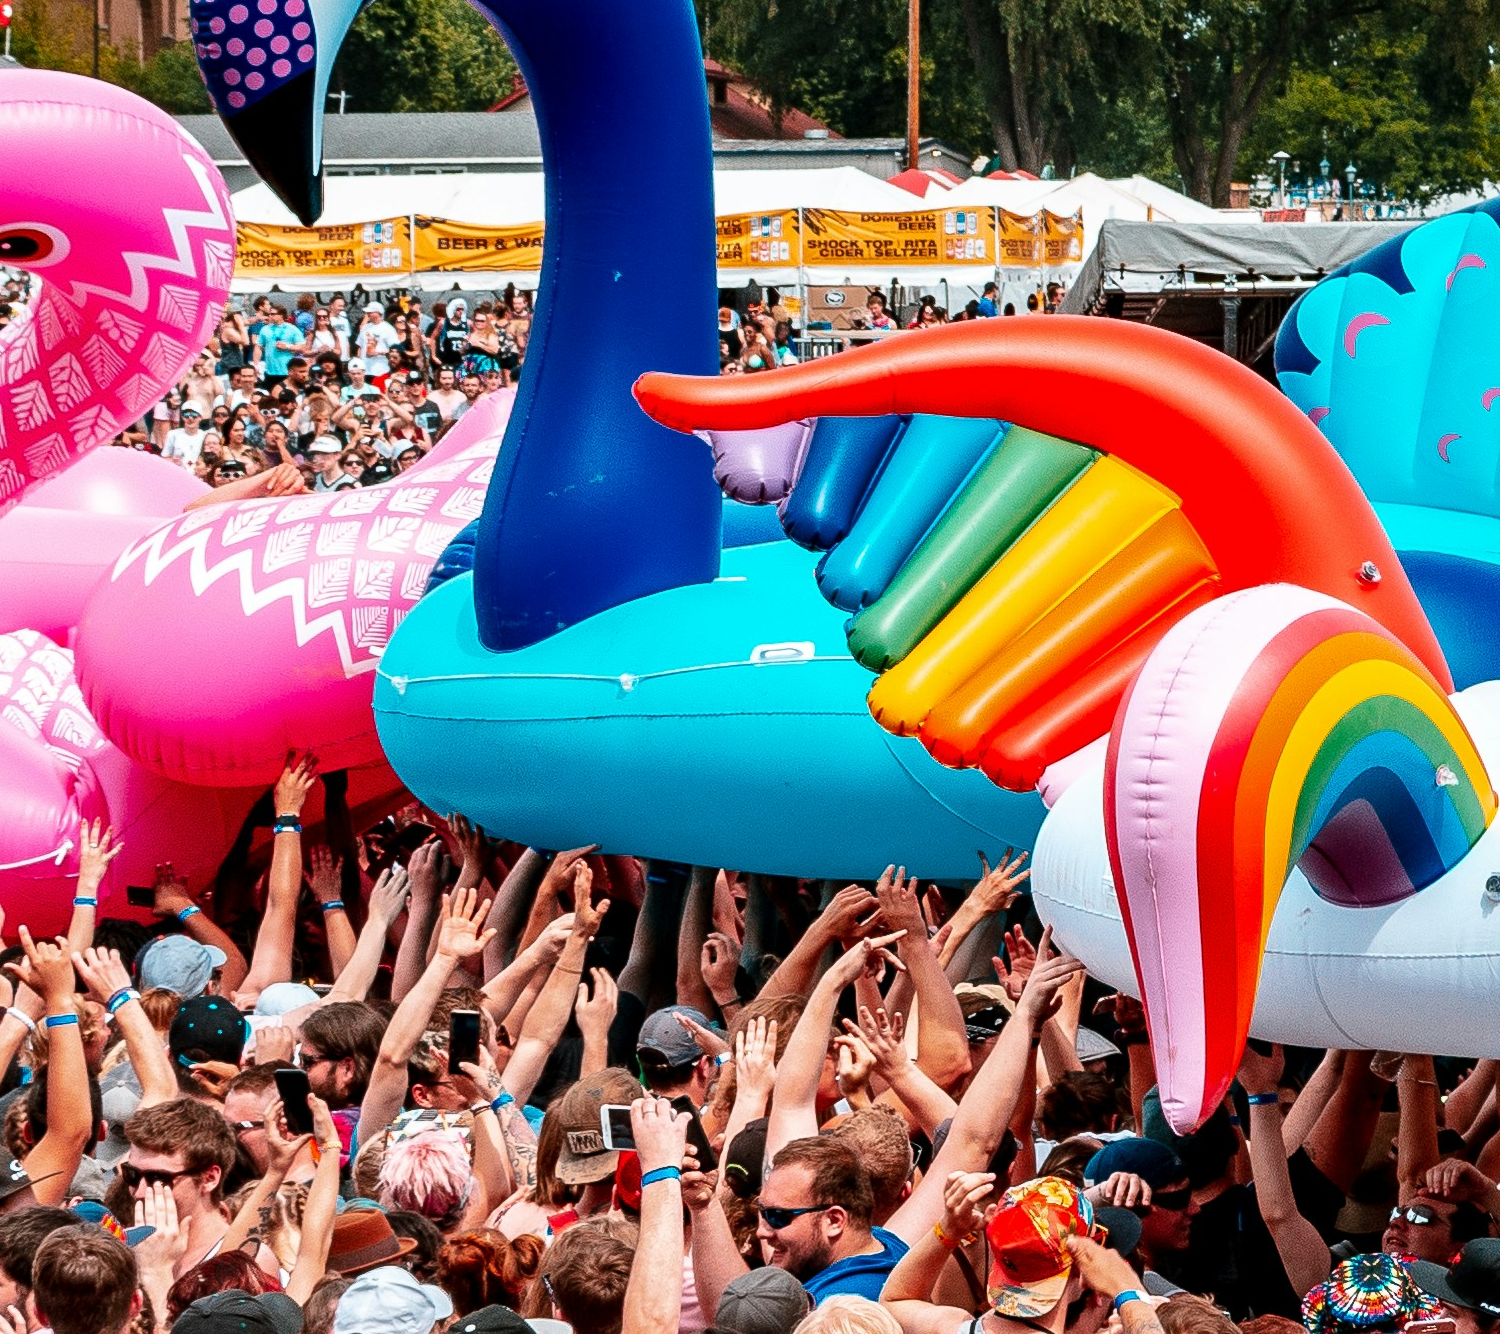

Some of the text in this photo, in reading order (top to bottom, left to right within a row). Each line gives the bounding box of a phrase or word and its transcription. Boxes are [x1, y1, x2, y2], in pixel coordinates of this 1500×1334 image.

[898, 222, 936, 231] BEER
[318, 233, 355, 242] BEER
[438, 237, 488, 249] BEER
[495, 238, 508, 250] &
[807, 240, 936, 249] SHOCK TOP RITA
[286, 250, 313, 259] TOP
[324, 249, 355, 258] RITA
[820, 248, 937, 258] CIDER SELTZER
[241, 258, 356, 267] CIDER SELTZER
